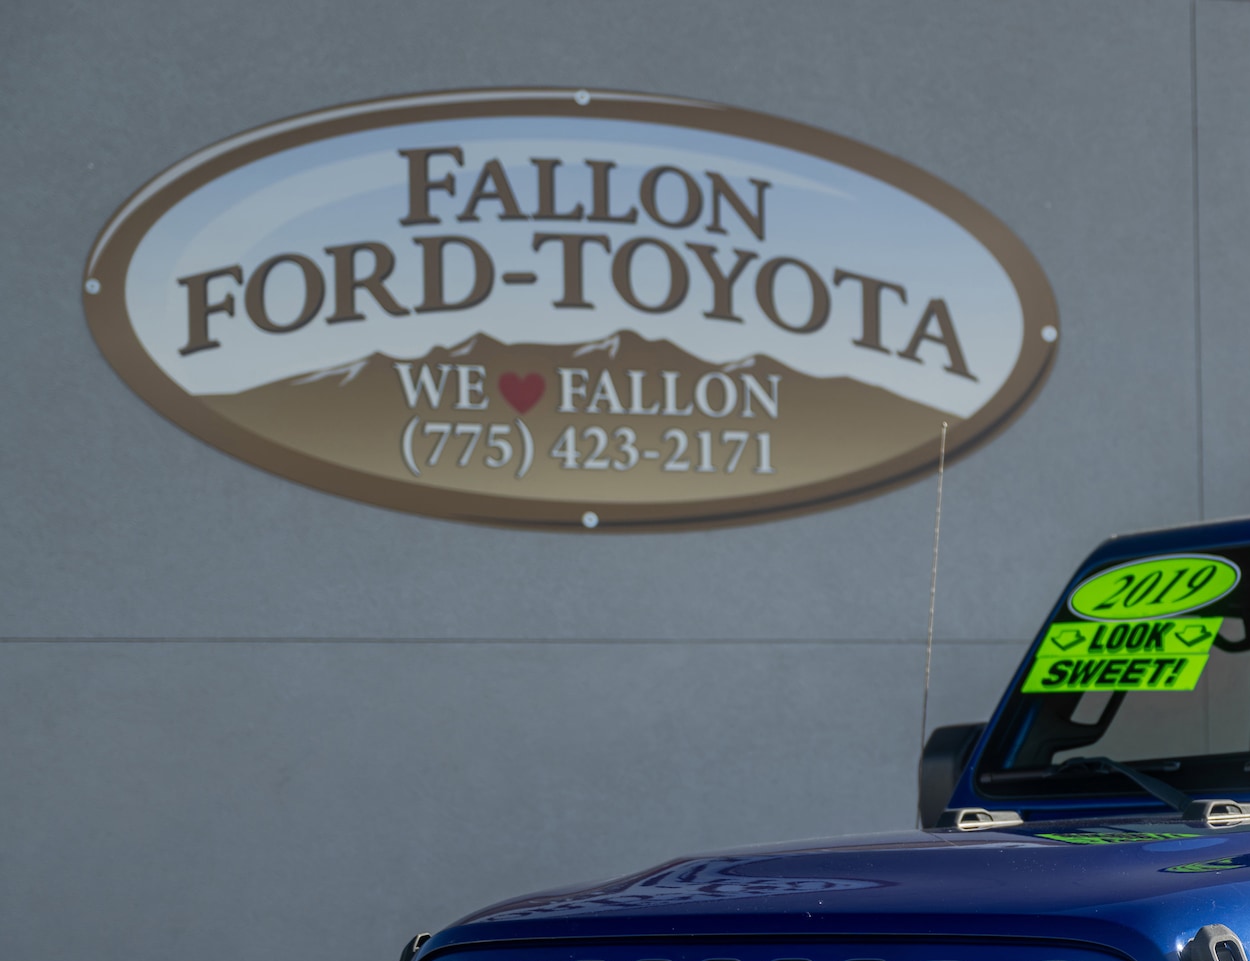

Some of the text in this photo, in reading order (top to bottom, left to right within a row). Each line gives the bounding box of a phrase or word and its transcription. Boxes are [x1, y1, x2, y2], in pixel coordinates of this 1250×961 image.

[398, 145, 772, 241] FALLON
[177, 231, 980, 382] FORD-TOYOTA
[393, 362, 782, 419] WE FALLON
[402, 415, 777, 478] (775) 423-2171
[1091, 564, 1218, 612] 2019
[1088, 622, 1176, 653] LOOK
[1041, 657, 1189, 688] SWEET!
